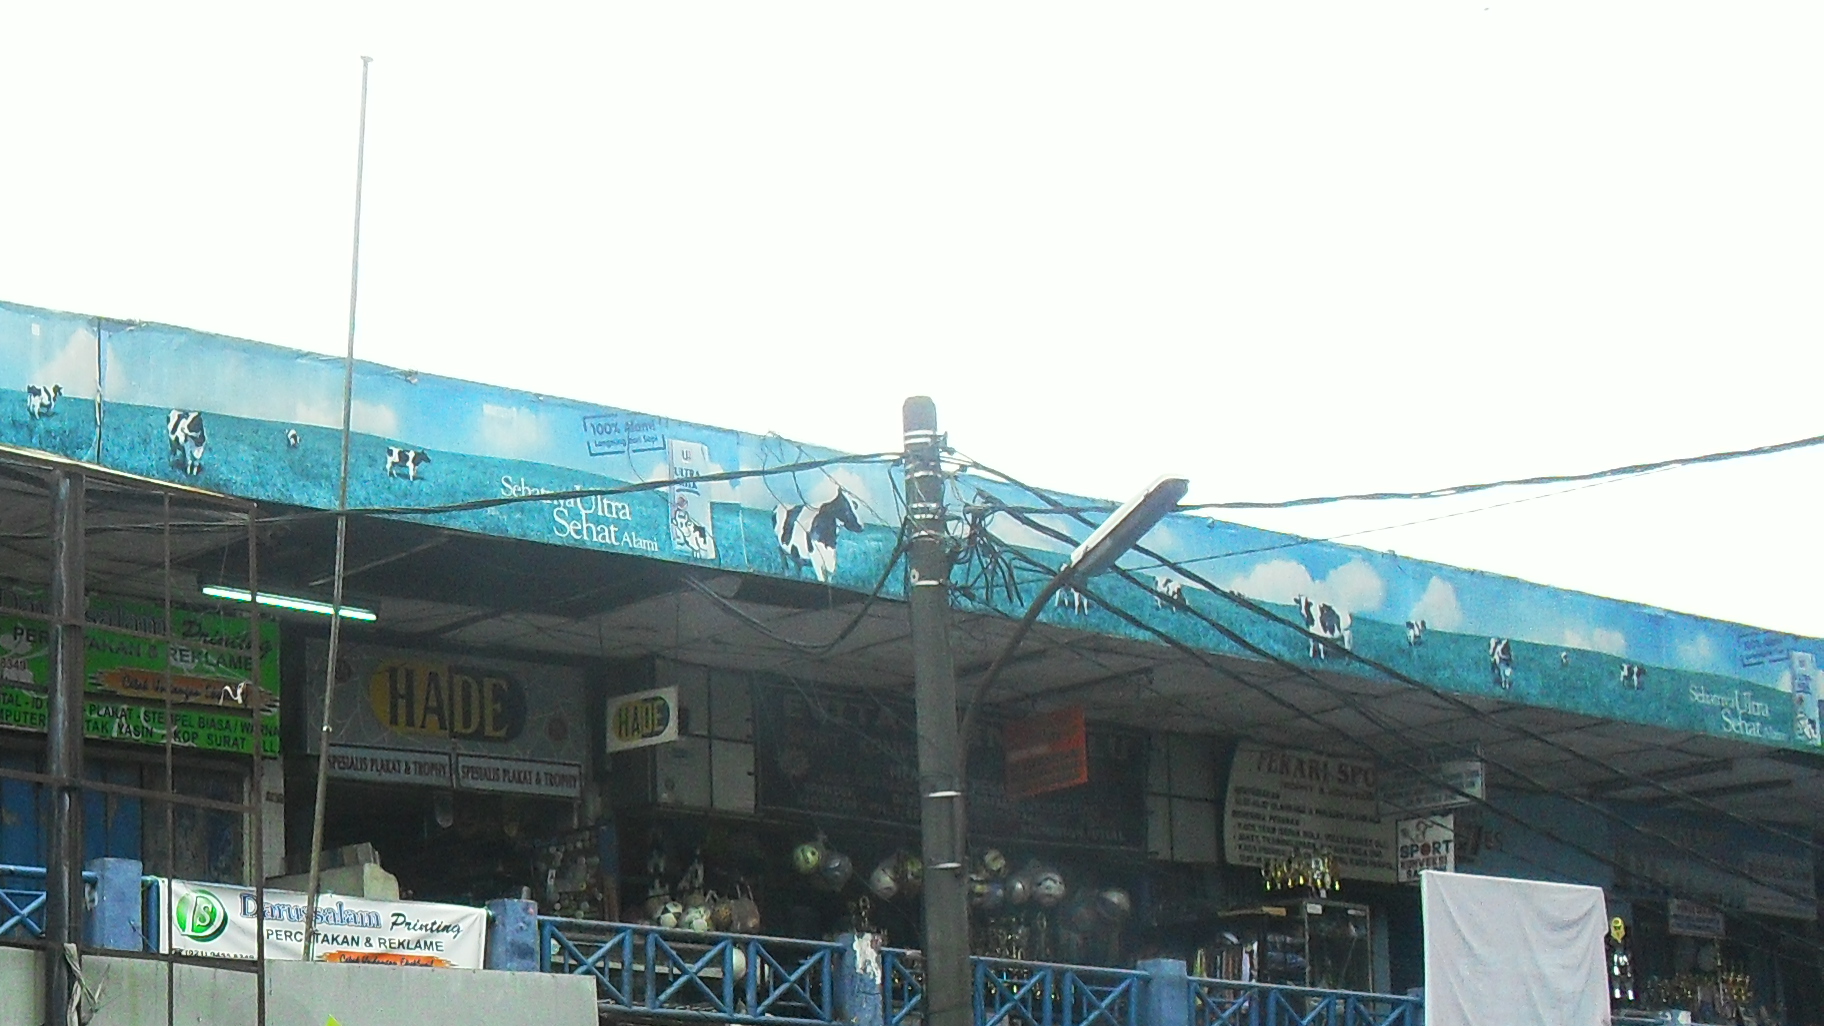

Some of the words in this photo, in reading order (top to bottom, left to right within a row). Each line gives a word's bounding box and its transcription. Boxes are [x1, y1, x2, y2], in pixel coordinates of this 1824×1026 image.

[553, 507, 620, 546] Sehat
[621, 531, 659, 552] Alami
[387, 665, 512, 739] HADE
[617, 698, 665, 739] HADE
[207, 733, 246, 750] SURAT
[239, 892, 383, 930] Darusalam
[389, 912, 464, 938] Printing
[266, 928, 361, 948] PERCTAKAN
[365, 936, 374, 949] &
[378, 936, 445, 952] REKLAME
